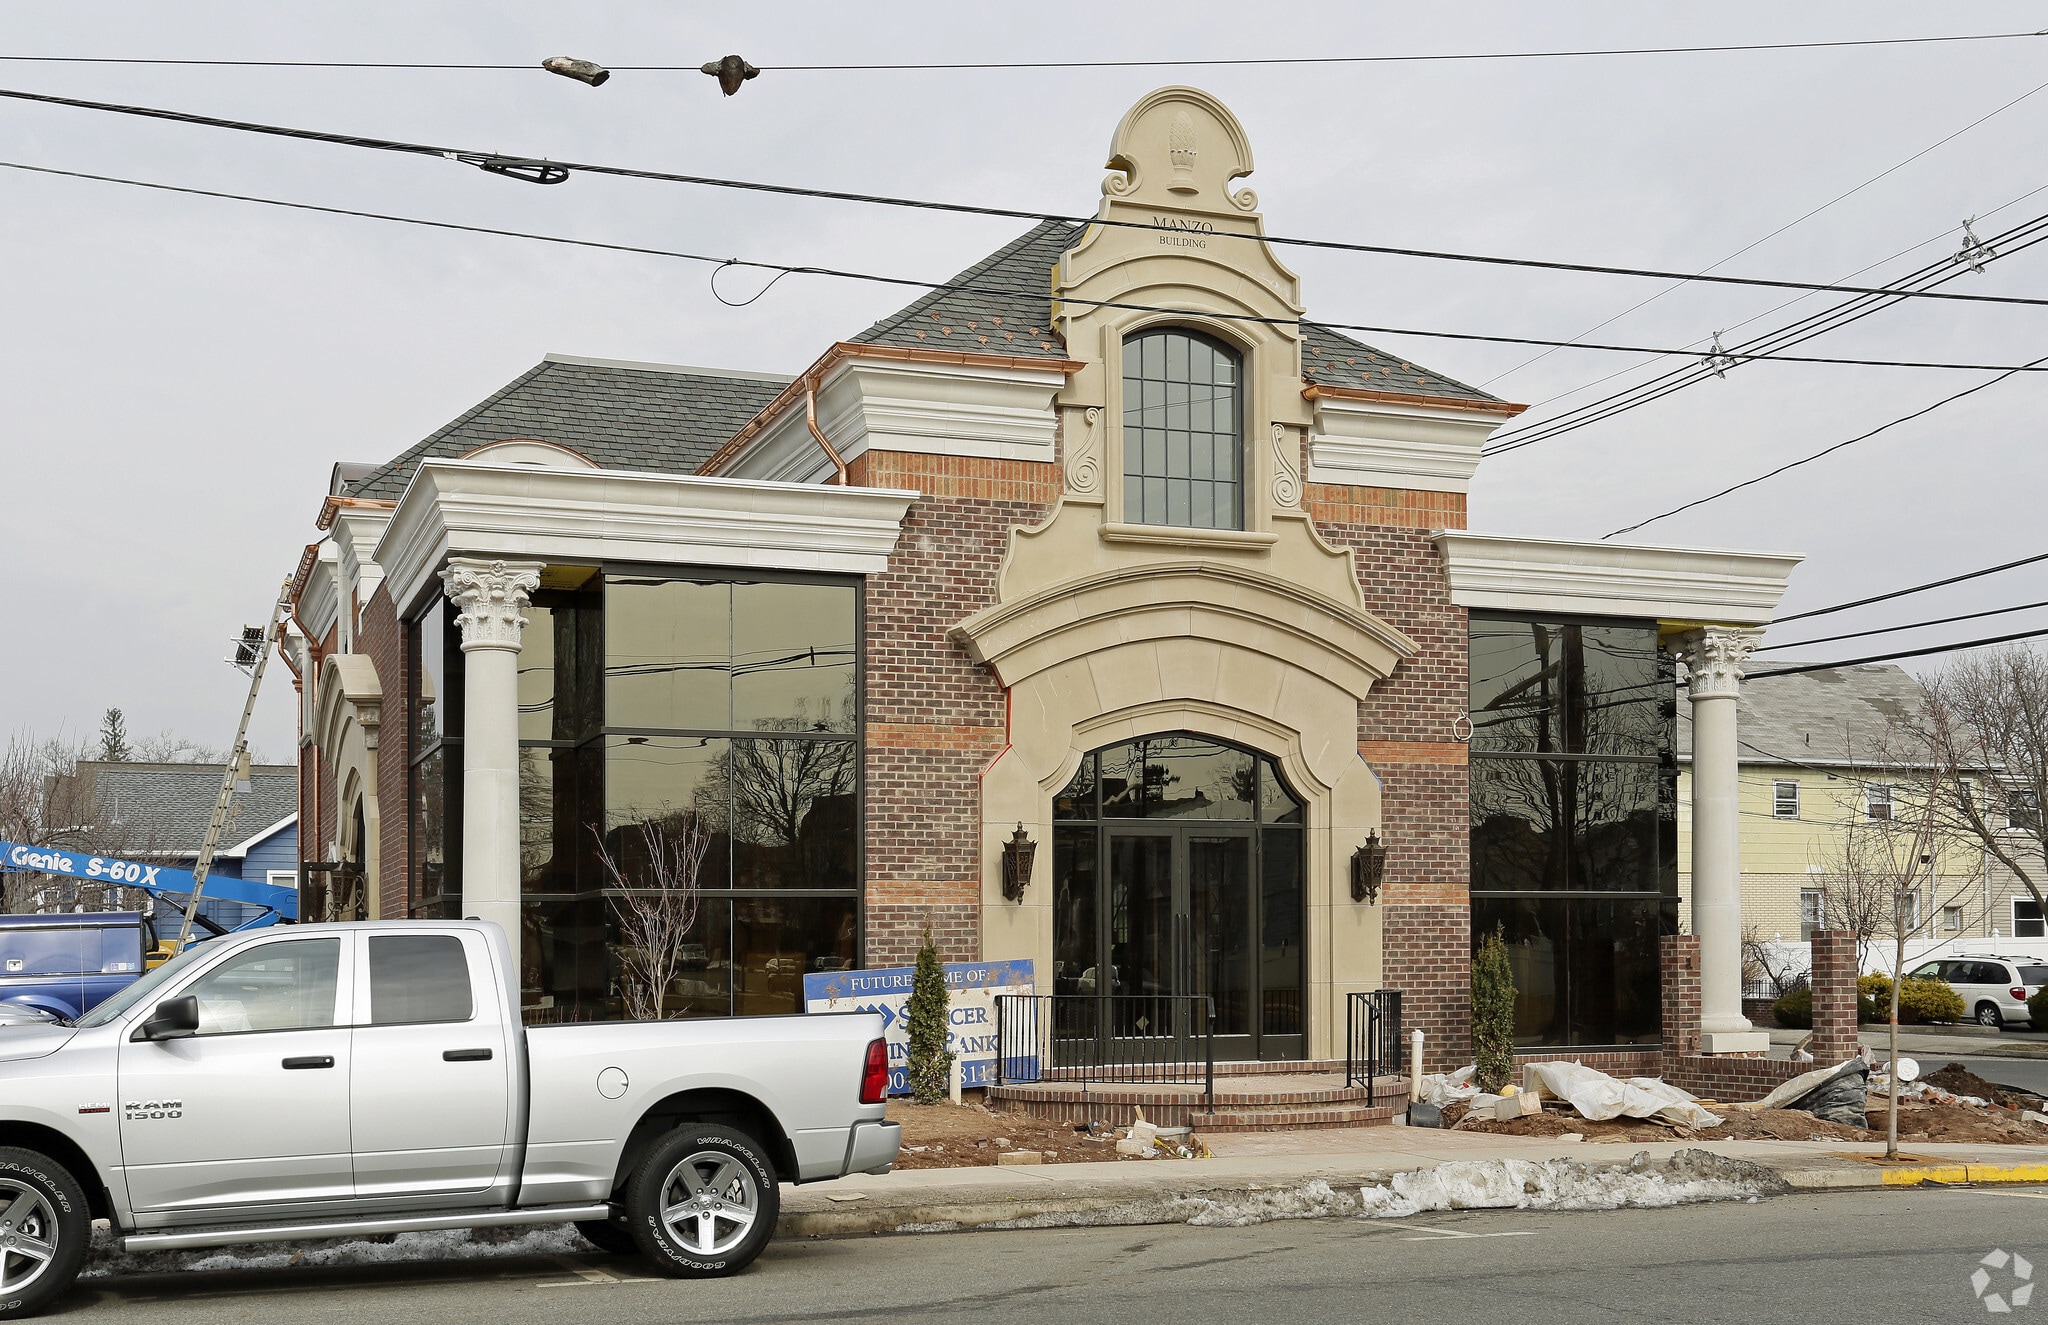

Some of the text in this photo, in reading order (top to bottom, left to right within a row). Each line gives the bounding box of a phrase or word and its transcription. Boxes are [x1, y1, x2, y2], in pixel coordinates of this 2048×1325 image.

[1153, 216, 1213, 236] MANZO
[1159, 235, 1206, 249] BUILDING
[11, 846, 74, 873] Genie
[851, 974, 912, 990] FUTURE
[125, 1100, 182, 1110] RAM
[126, 1111, 182, 1120] 1500
[696, 1137, 770, 1189] WRANGLER
[648, 1215, 726, 1270] GOODYEAR
